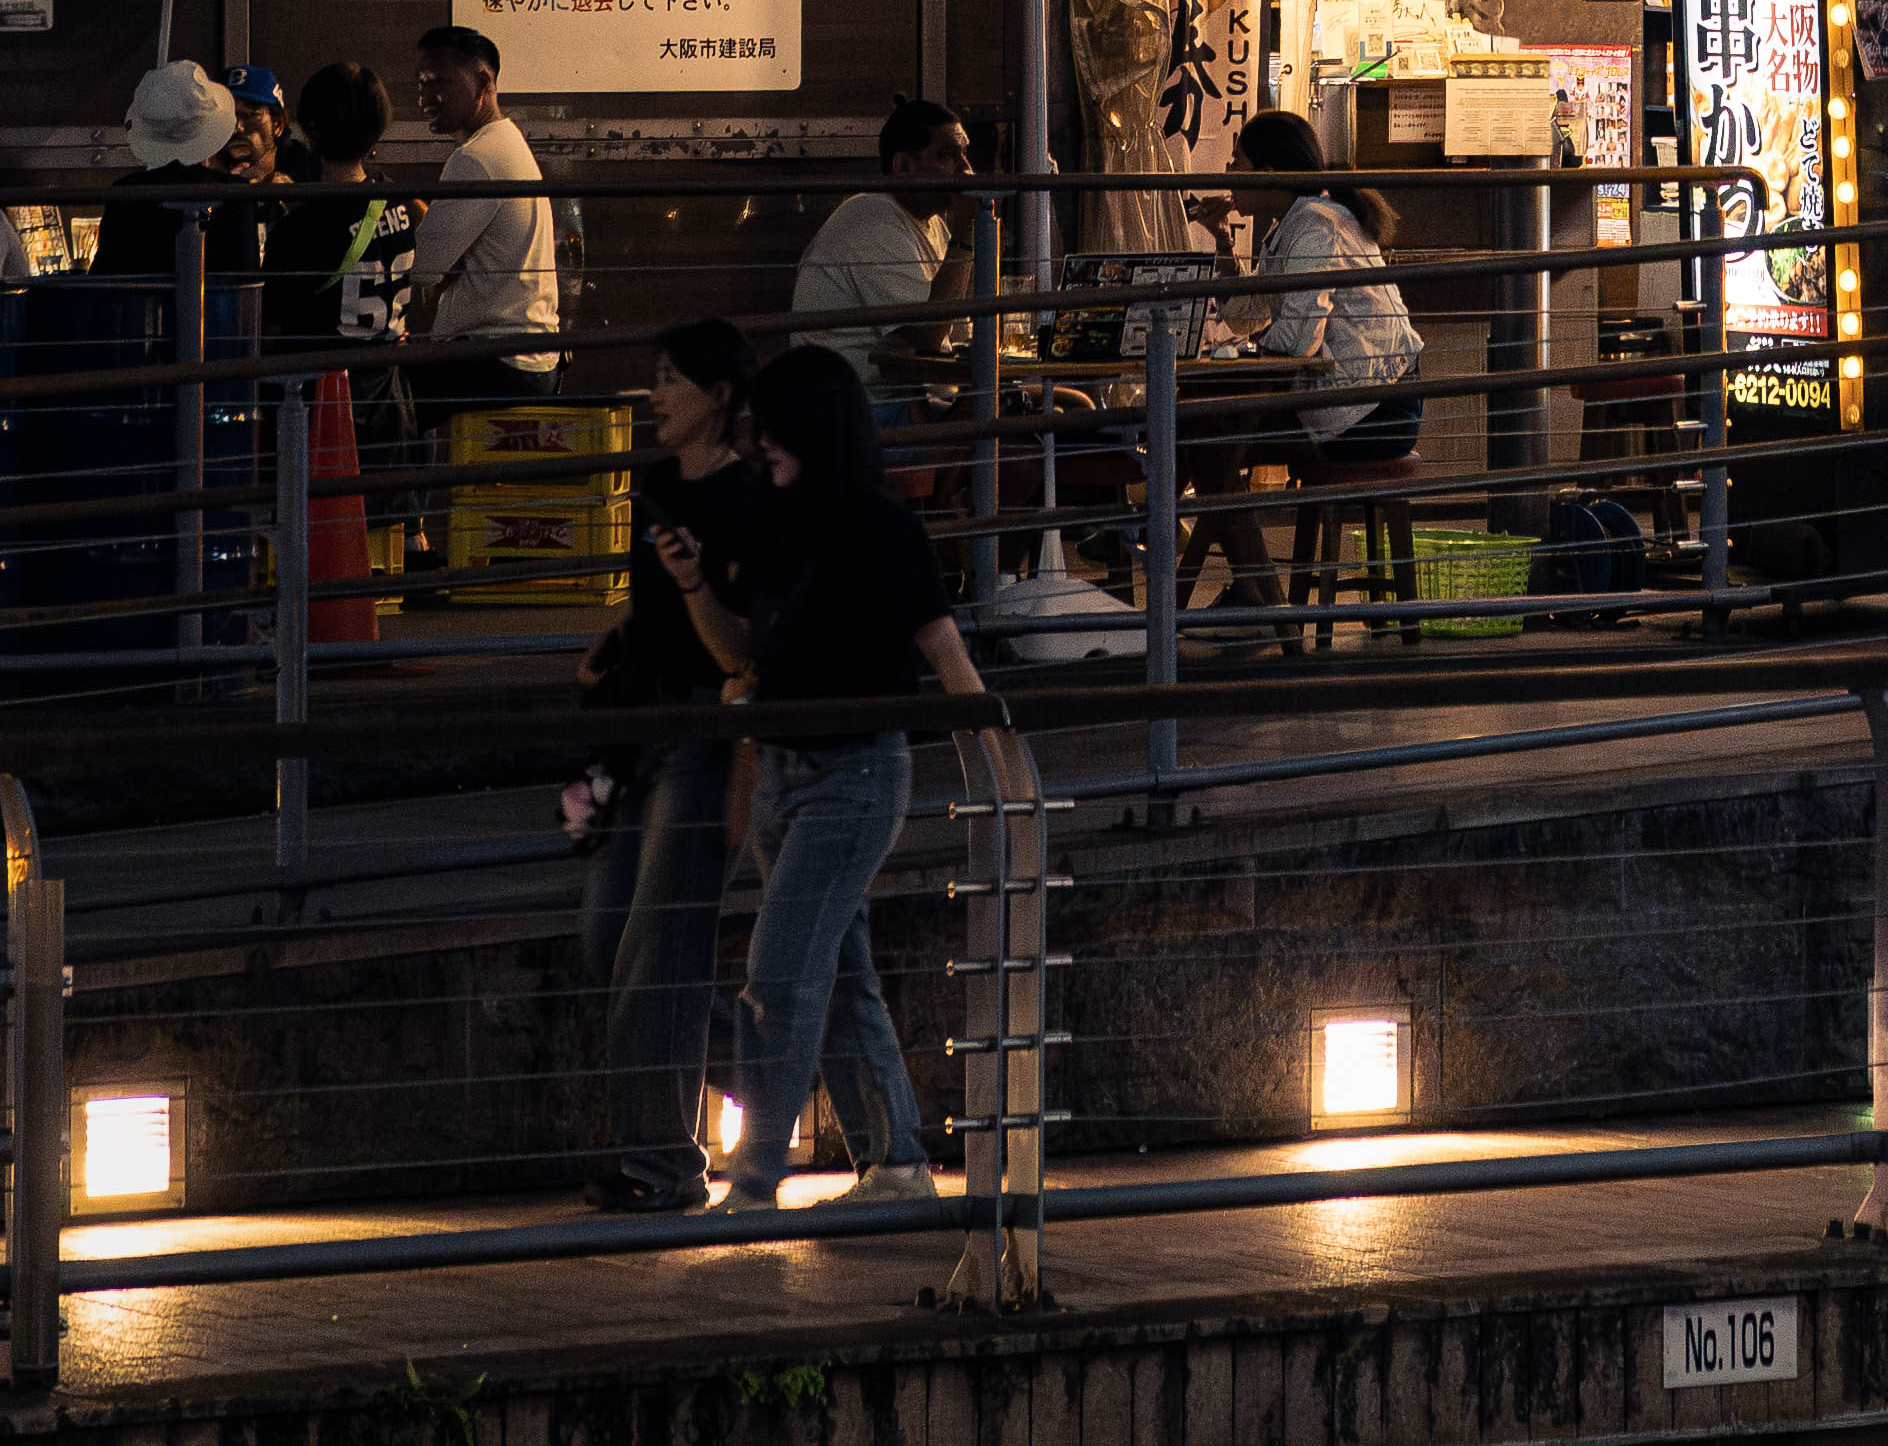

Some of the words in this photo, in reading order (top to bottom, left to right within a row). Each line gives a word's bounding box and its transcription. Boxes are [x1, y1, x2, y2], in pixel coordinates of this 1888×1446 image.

[1762, 2, 1817, 47] 大阪
[658, 37, 777, 61] 大阪市建設局
[1766, 48, 1819, 94] 名物
[349, 204, 410, 238] ENS
[1726, 372, 1831, 409] -6212-0094
[1684, 1311, 1775, 1374] No.106
